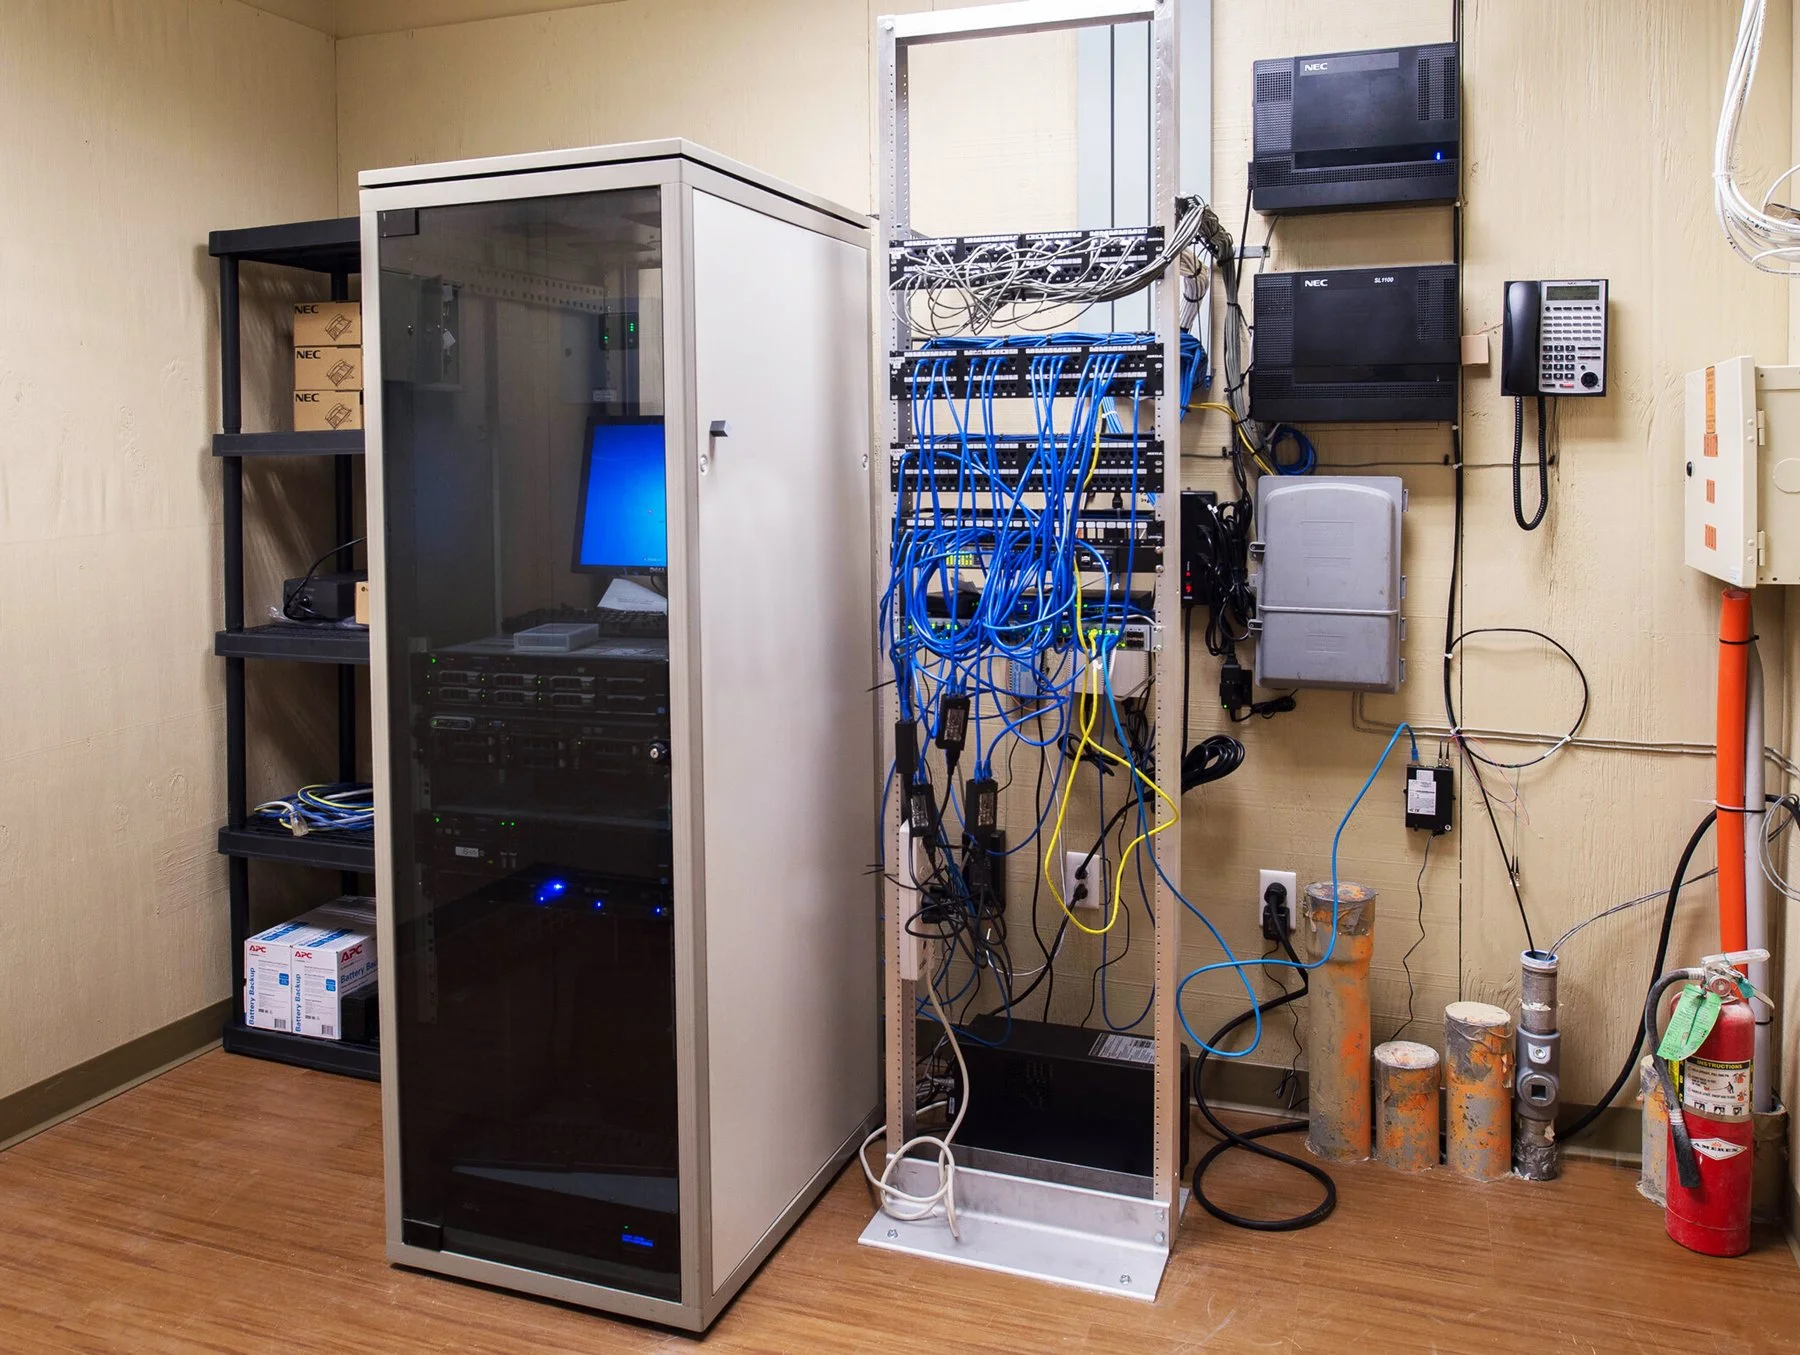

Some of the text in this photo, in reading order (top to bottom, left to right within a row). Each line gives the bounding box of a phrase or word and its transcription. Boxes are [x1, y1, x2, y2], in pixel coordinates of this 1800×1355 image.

[304, 62, 328, 71] NEC
[304, 279, 328, 287] NEC
[374, 276, 394, 284] SL1100
[294, 304, 319, 314] NEC
[296, 350, 321, 359] NEC
[295, 393, 319, 402] NEC
[249, 945, 267, 953] APC
[341, 944, 363, 963] APC
[294, 951, 312, 959] APC
[341, 966, 365, 984] Battery
[248, 967, 256, 1025] Battery Backup
[294, 973, 302, 1032] Battery Backup
[1696, 1060, 1743, 1070] INSTRUCTIONS
